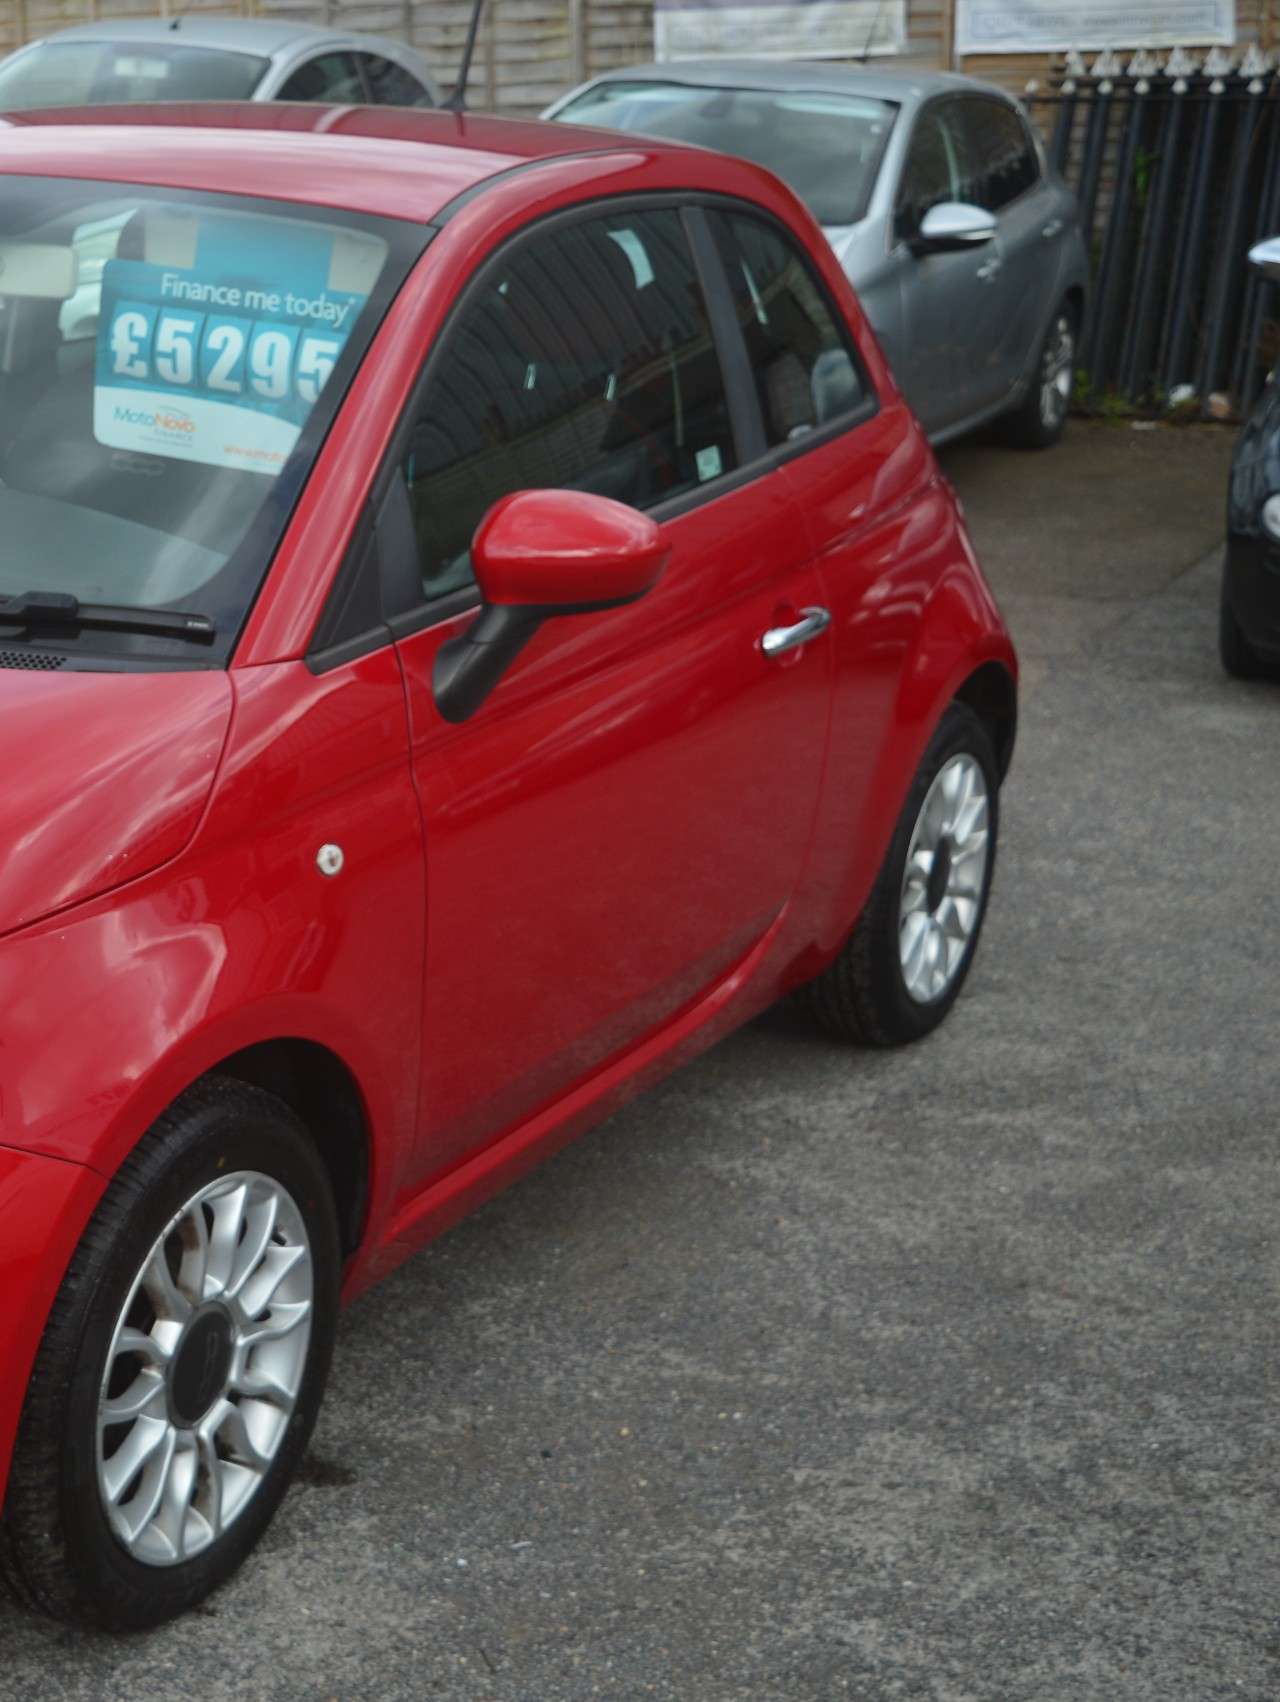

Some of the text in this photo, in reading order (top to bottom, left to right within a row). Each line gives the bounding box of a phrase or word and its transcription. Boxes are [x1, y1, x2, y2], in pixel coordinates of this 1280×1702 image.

[160, 272, 240, 306] Finance
[244, 290, 281, 310] me
[110, 311, 339, 403] £5295
[113, 404, 197, 433] MotoNovo
